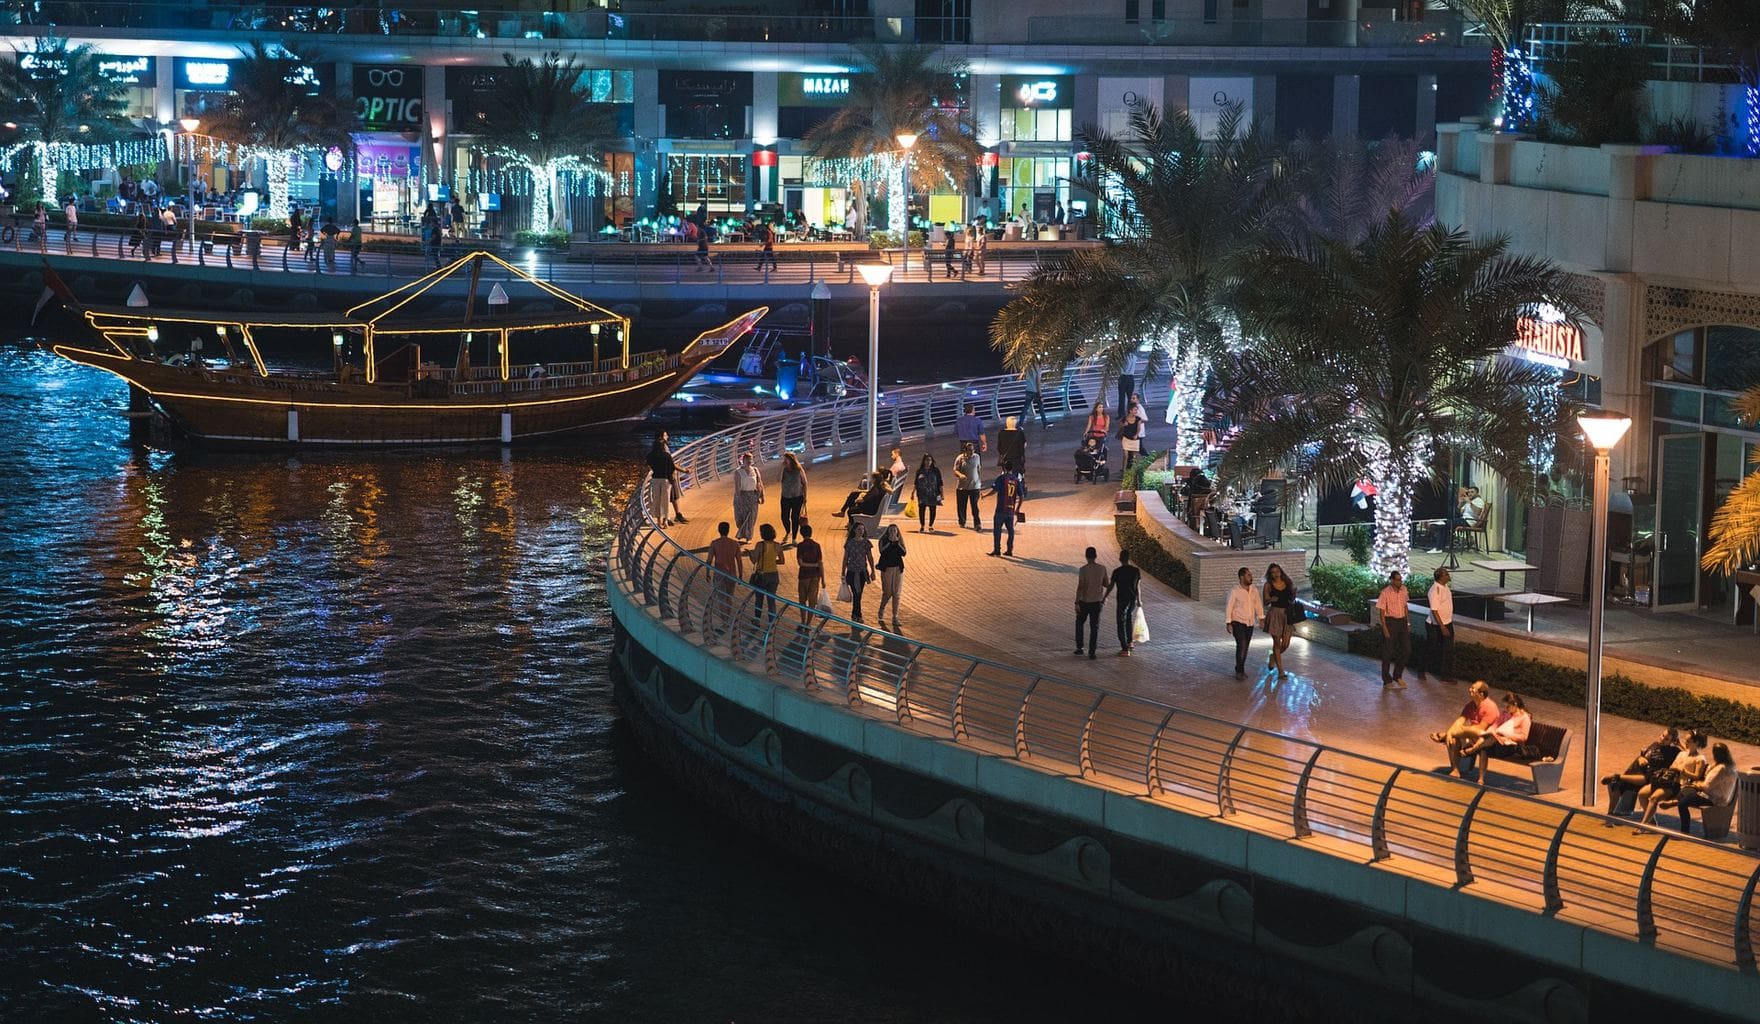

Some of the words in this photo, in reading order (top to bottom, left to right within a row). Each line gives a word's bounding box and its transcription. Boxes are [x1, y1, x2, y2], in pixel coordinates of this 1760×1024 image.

[803, 78, 849, 94] MAZAH
[353, 96, 422, 123] OPTIC
[1007, 484, 1015, 496] 10
